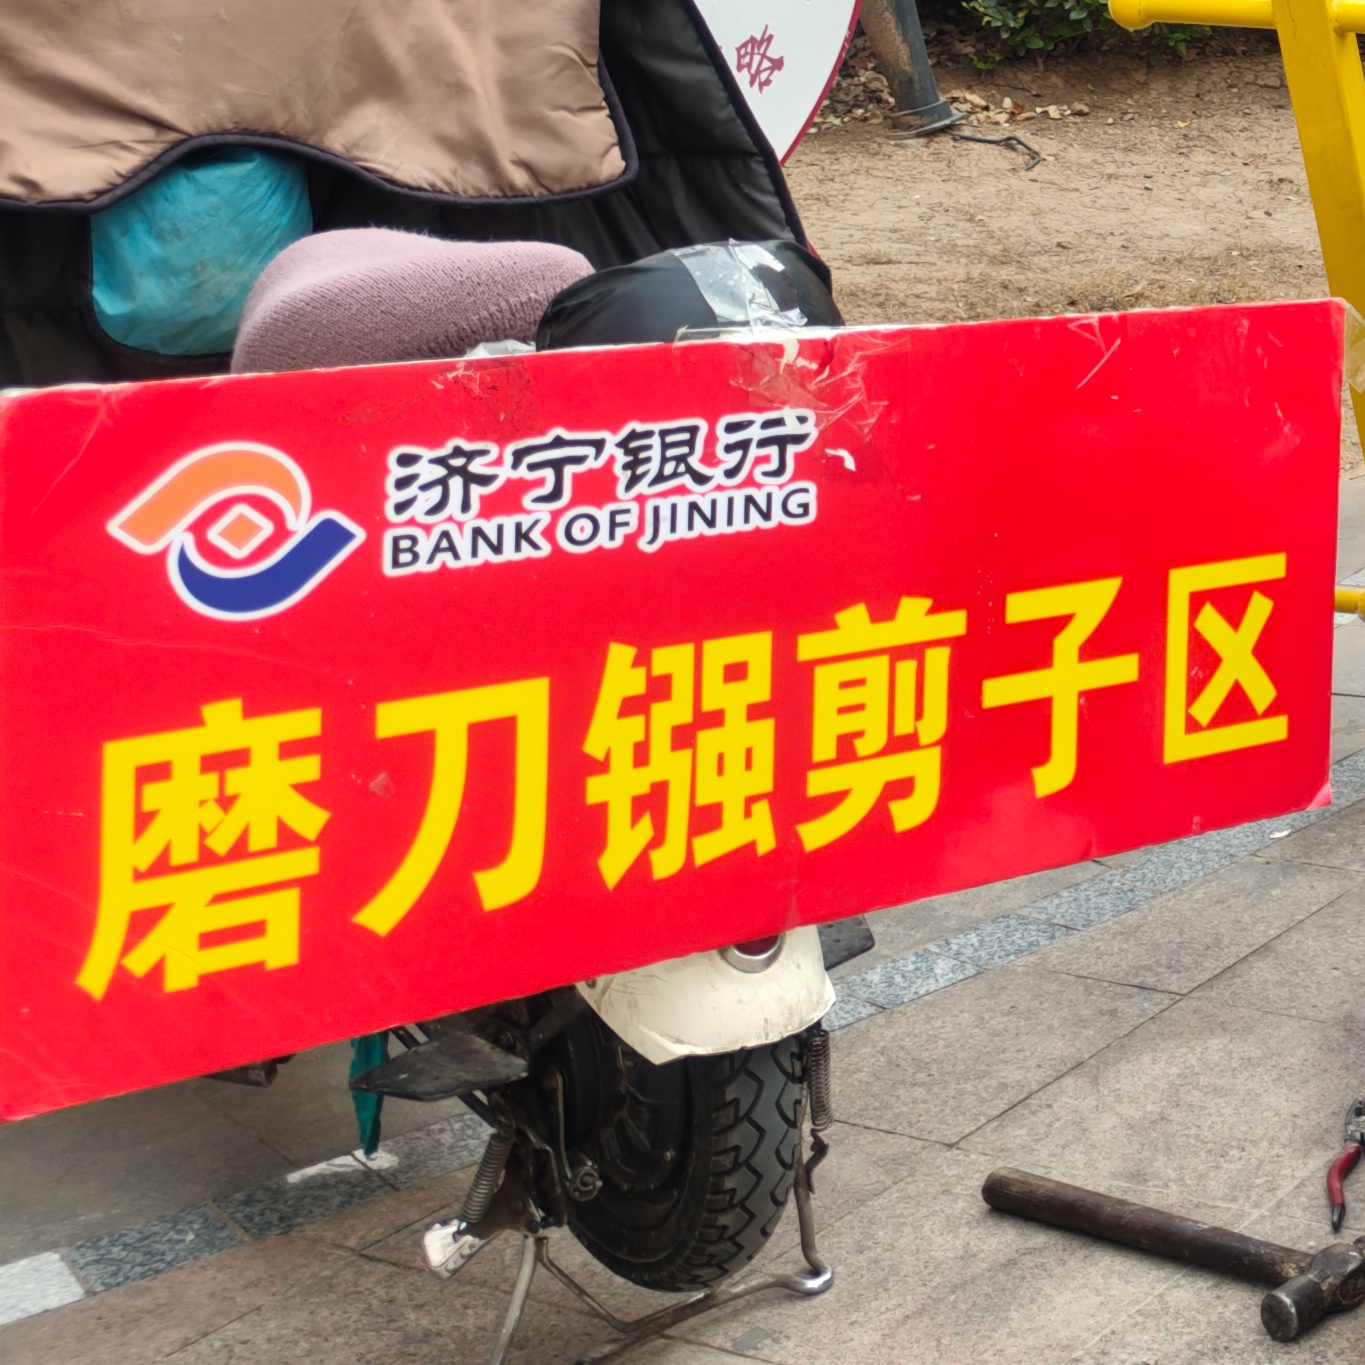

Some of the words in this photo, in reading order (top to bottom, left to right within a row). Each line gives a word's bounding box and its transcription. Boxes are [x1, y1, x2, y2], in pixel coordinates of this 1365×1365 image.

[391, 413, 814, 519] 济宁银行
[390, 518, 545, 571] BANK
[563, 507, 633, 548] OF
[645, 486, 812, 546] JINING
[74, 553, 1289, 1003] 磨刀镪剪子区
